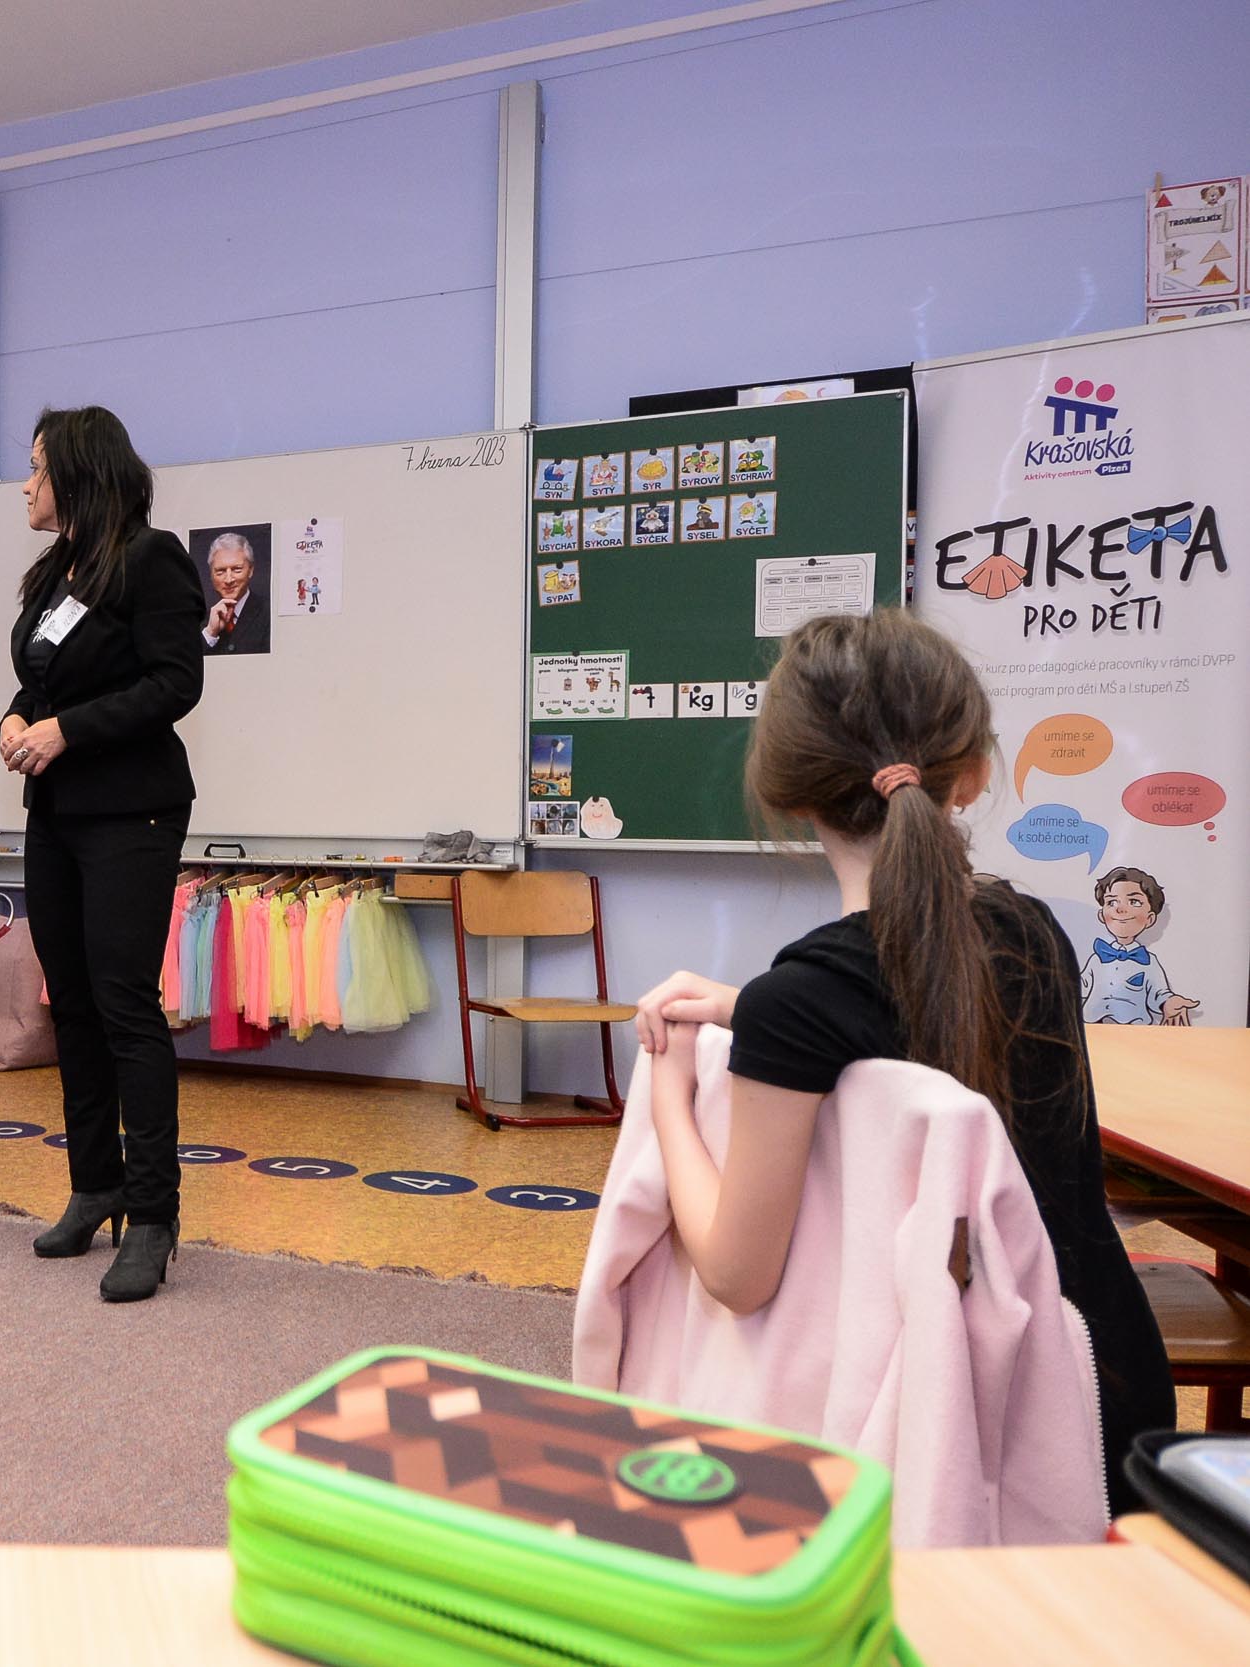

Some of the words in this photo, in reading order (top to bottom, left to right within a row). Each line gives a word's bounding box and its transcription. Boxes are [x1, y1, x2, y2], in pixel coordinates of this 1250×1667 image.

[469, 435, 507, 467] 2023
[1024, 428, 1134, 467] Krašovská
[1024, 472, 1057, 481] Aktivity
[1058, 469, 1092, 478] centrum
[1101, 463, 1128, 475] Plzeň
[681, 474, 720, 487] SYROVÝ
[545, 491, 563, 499] SYN
[687, 531, 718, 540] SYSEL
[736, 526, 768, 536] SYČET
[539, 541, 577, 552] USYCHAT
[935, 501, 1228, 592] ETIKETA
[546, 593, 574, 604] SYPAT
[1023, 604, 1078, 638] PRO
[1092, 583, 1163, 633] DĚTI
[538, 657, 578, 667] Jednotky
[580, 655, 623, 664] hmotnosti
[985, 664, 1007, 674] kurz
[1009, 664, 1026, 675] pro
[1028, 660, 1096, 674] pedagogické
[1098, 657, 1158, 672] pracovníky
[1161, 660, 1167, 668] v
[1169, 655, 1200, 669] rámci
[1202, 654, 1236, 667] DVPP
[1011, 685, 1055, 698] program
[1057, 685, 1075, 697] pro
[1076, 683, 1097, 695] děti
[1099, 679, 1117, 694] MŠ
[1119, 684, 1126, 693] a
[1175, 678, 1190, 693] ZŠ
[689, 691, 714, 711] kg
[745, 694, 757, 710] g
[1044, 730, 1080, 742] umíme
[1082, 732, 1094, 742] se
[1050, 747, 1086, 758] zdravit
[1146, 784, 1186, 796] umíme
[1187, 786, 1200, 796] se
[1152, 801, 1194, 813] oblékat
[1029, 816, 1064, 828] umíme
[1067, 818, 1079, 827] se
[1018, 832, 1024, 842] k
[1025, 831, 1051, 844] sobě
[1053, 832, 1089, 845] chovat
[269, 1161, 330, 1175] 5
[391, 1175, 450, 1190] 4
[510, 1190, 577, 1207] 3
